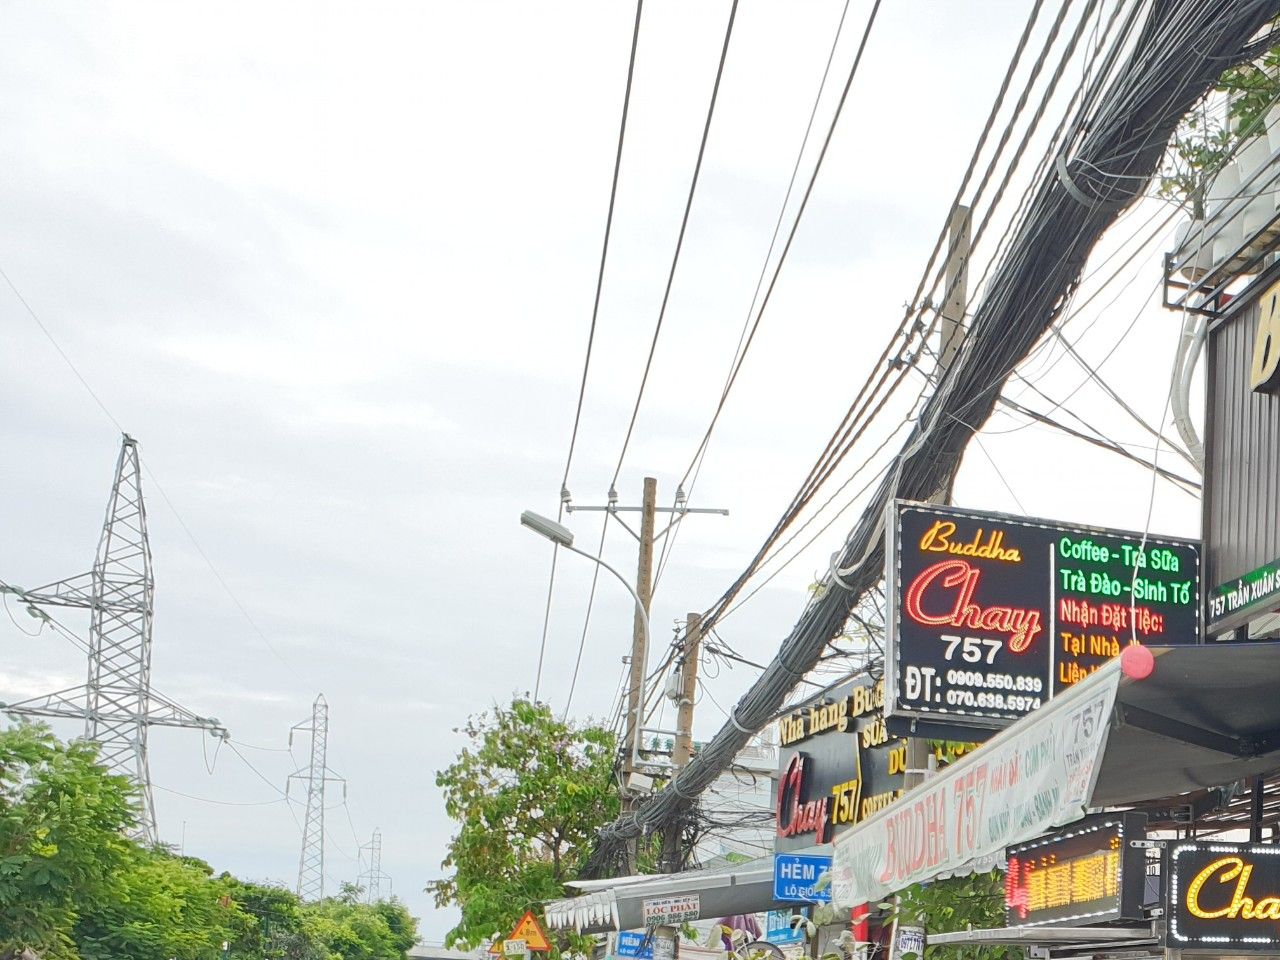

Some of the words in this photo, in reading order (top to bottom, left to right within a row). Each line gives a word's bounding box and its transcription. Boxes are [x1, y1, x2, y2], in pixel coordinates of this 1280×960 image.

[921, 520, 1022, 562] Buddha
[1060, 537, 1109, 563] Coffee
[1122, 545, 1146, 569] Trà
[1151, 549, 1180, 573] Sữa
[1060, 569, 1086, 592] Trà
[1090, 572, 1121, 597] Đào
[1133, 577, 1167, 603] Sinh
[1170, 581, 1191, 605] Tố
[1210, 595, 1226, 618] 757
[1228, 580, 1250, 611] TRẦN
[1251, 573, 1275, 602] XUÂN
[906, 559, 1042, 653] Chay
[1060, 598, 1098, 629] Nhận
[1102, 604, 1126, 632] Đặt
[940, 635, 1003, 665] 757
[1060, 632, 1086, 657] Tại
[1090, 634, 1120, 656] Nhà
[776, 751, 829, 846] Chay
[832, 779, 858, 825] 757
[954, 761, 989, 858] 757
[781, 858, 815, 880] HẺM
